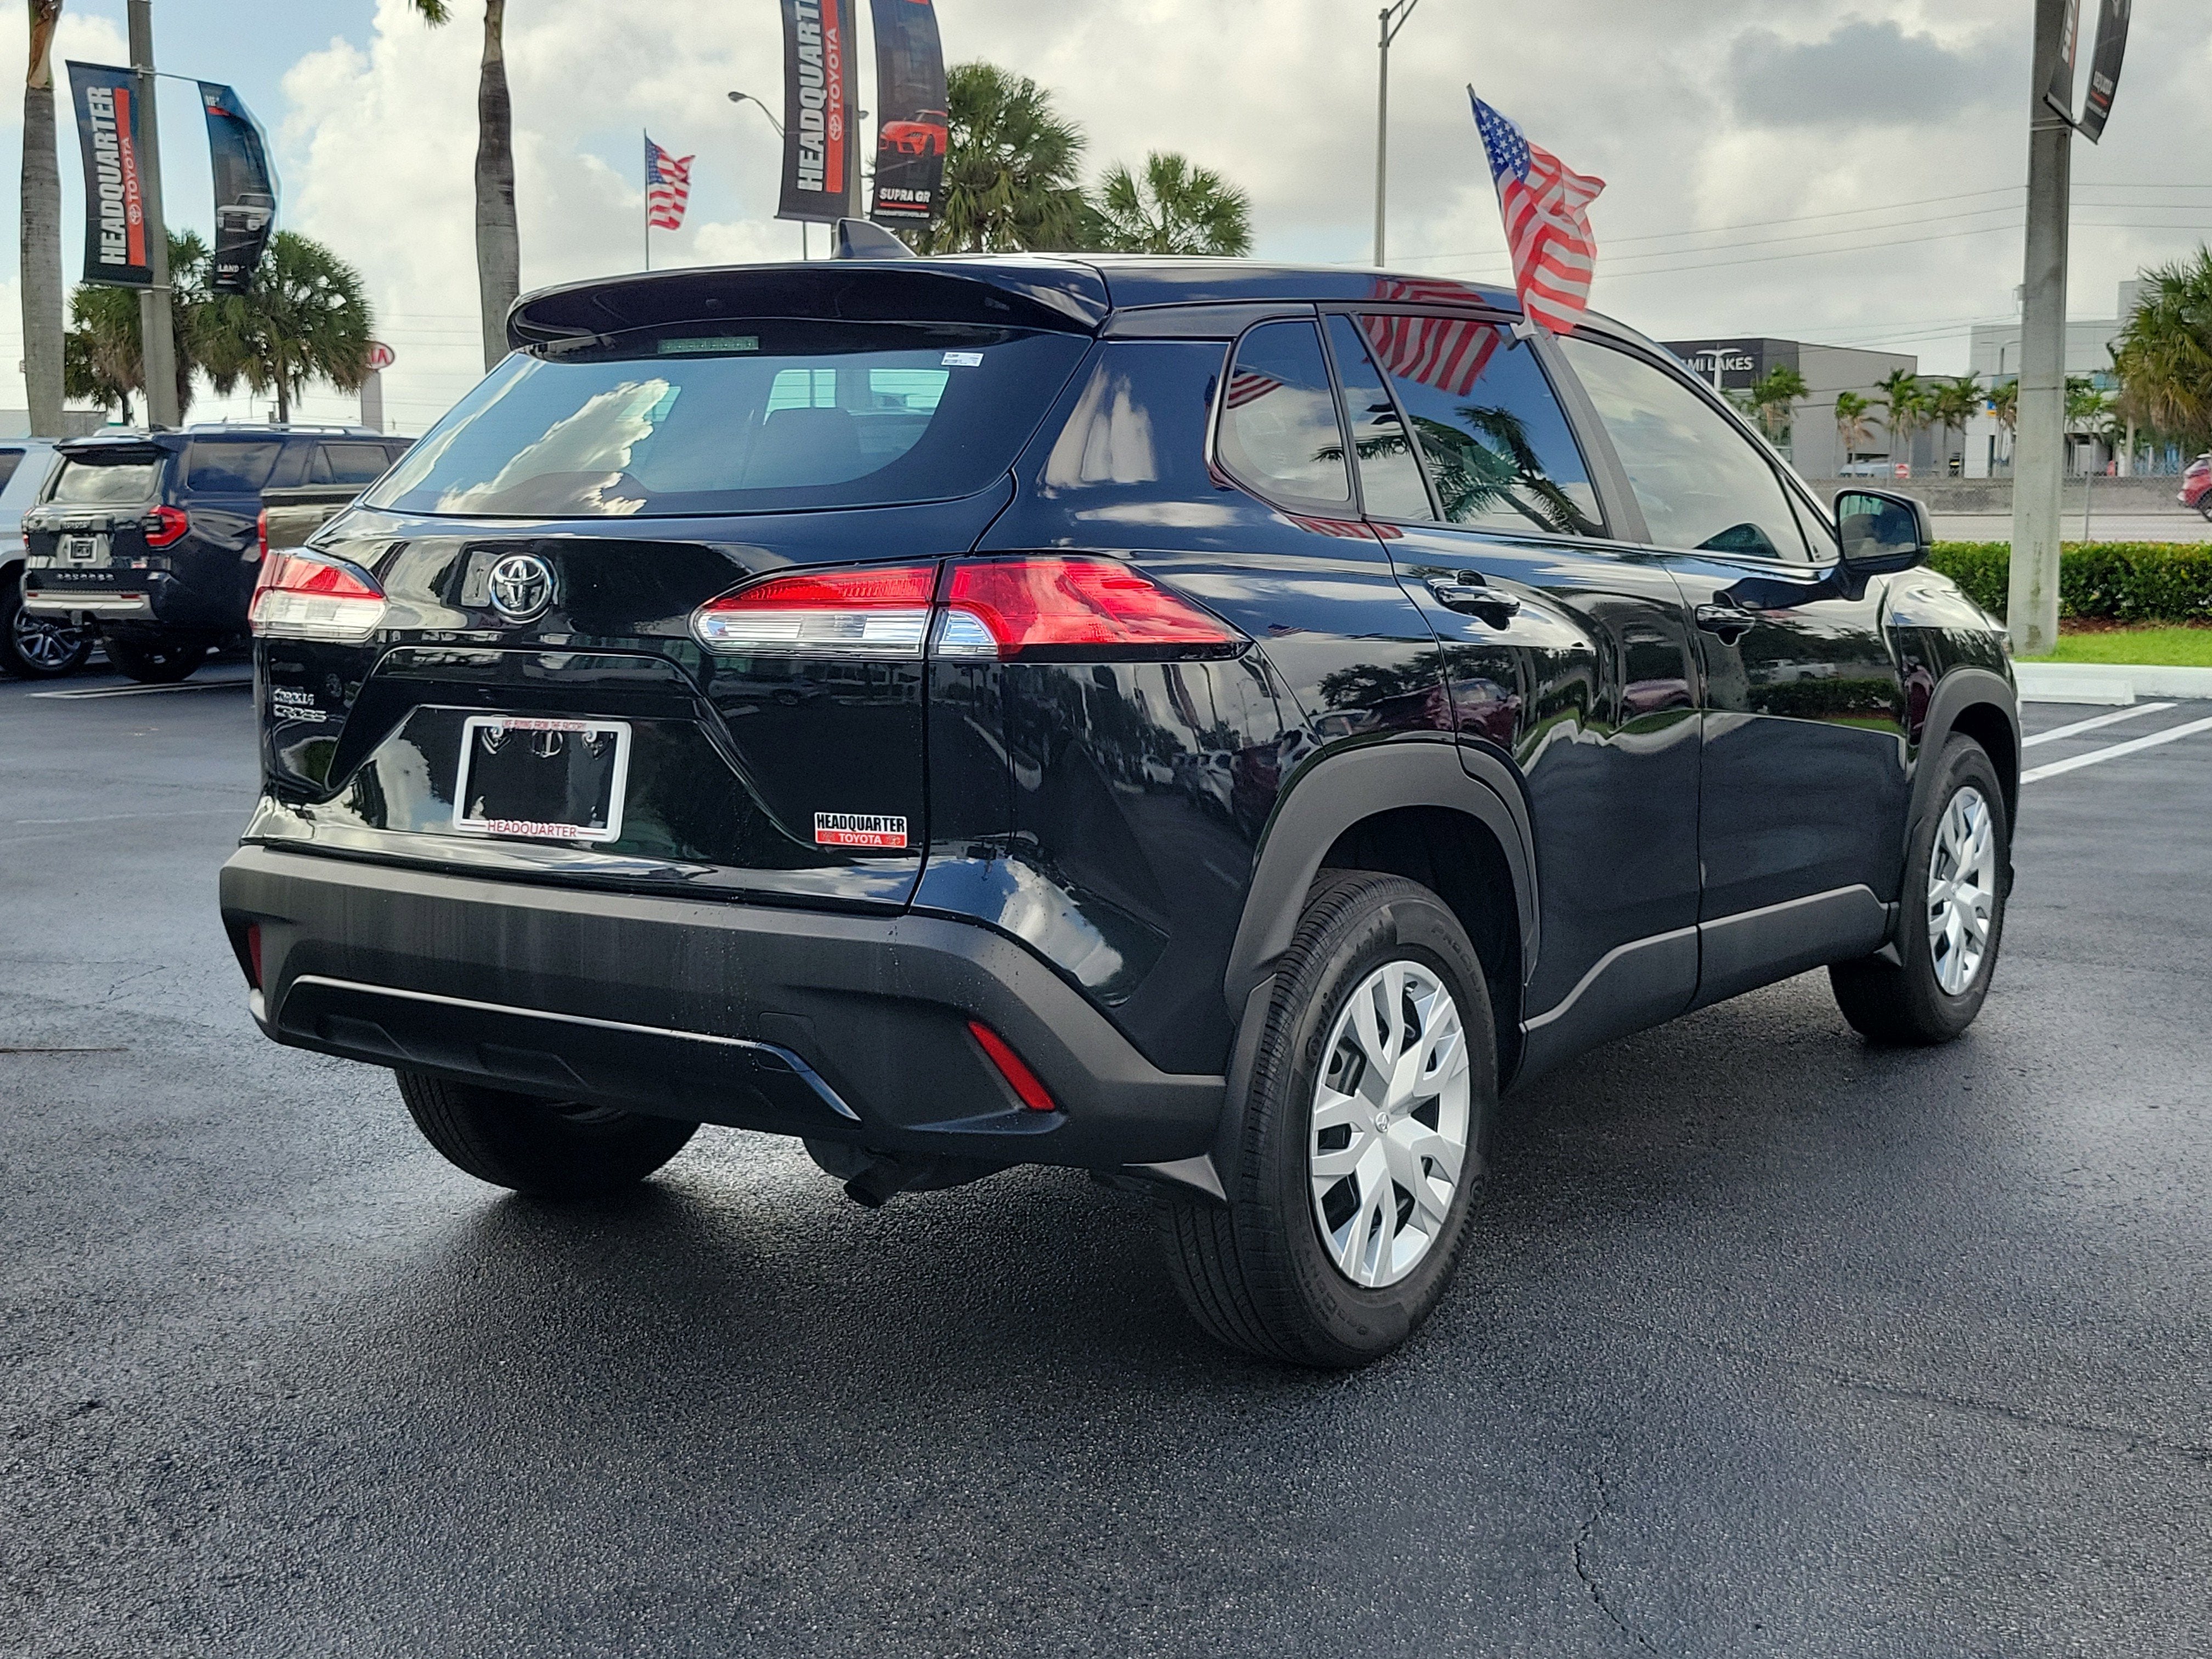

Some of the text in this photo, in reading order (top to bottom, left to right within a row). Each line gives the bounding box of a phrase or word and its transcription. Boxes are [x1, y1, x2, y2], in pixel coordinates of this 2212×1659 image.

[826, 28, 841, 112] TOYOTA
[795, 0, 827, 191] HEADQUART
[87, 86, 127, 265] HEADQUARTER
[121, 137, 139, 202] TOYOTA
[879, 188, 931, 203] SUPRA GR
[487, 820, 577, 837] HEADQUARTER
[816, 814, 905, 833] HEADQUARTER
[838, 833, 882, 844] TOYOTA
